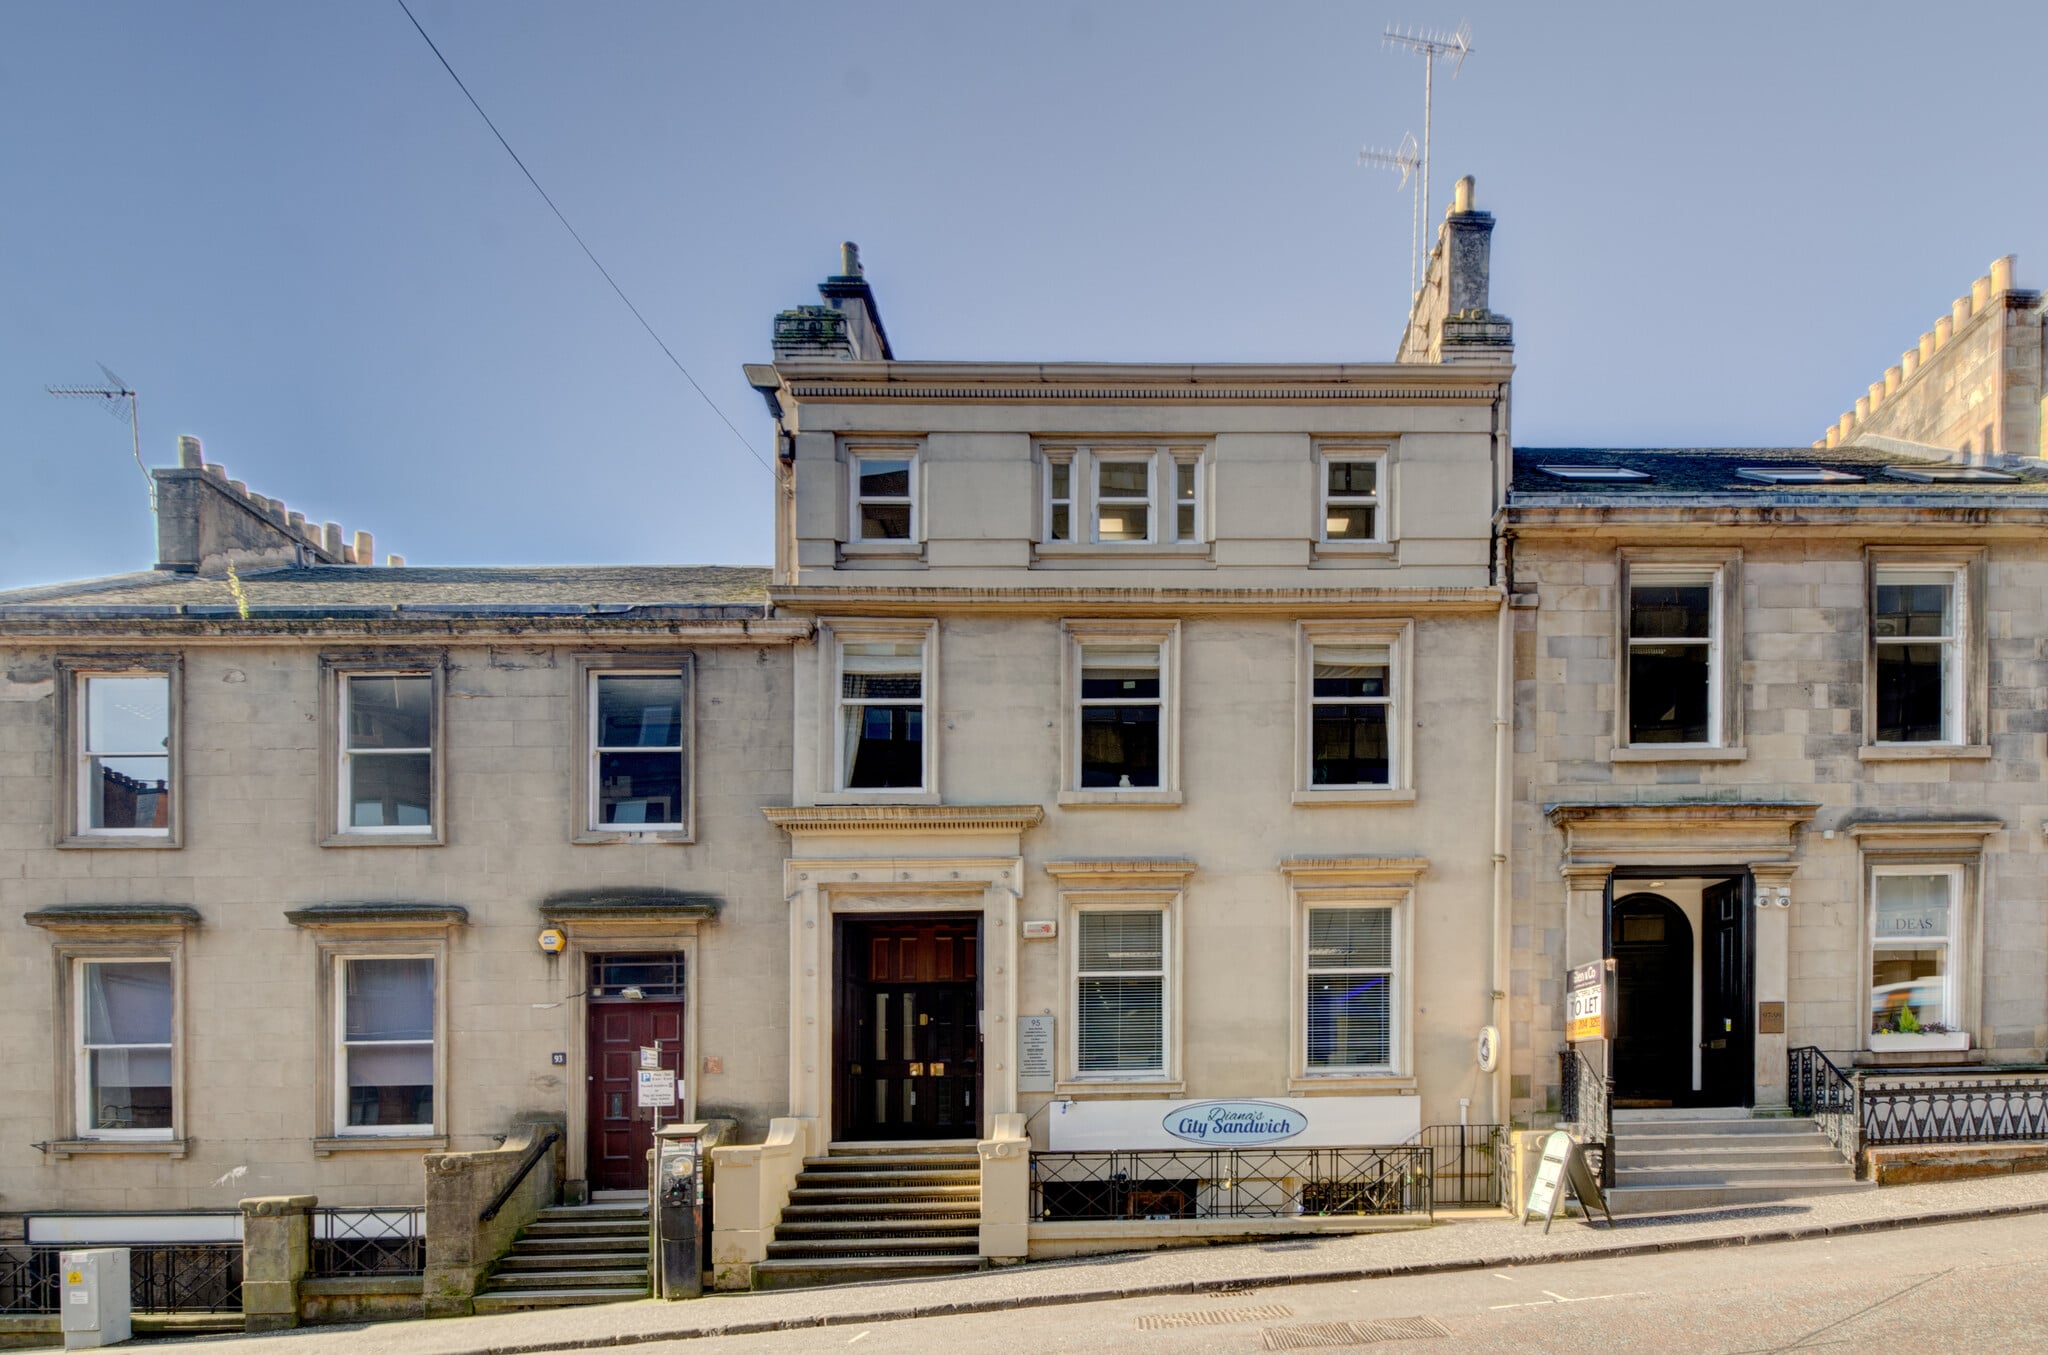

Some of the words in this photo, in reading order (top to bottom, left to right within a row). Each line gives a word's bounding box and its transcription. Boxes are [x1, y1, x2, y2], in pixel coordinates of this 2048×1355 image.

[1570, 1000, 1582, 1017] TO
[1585, 996, 1598, 1014] LET
[554, 1055, 563, 1063] 93
[1208, 1107, 1263, 1121] Diana's
[1179, 1118, 1208, 1138] City
[1212, 1118, 1290, 1134] Sandwich
